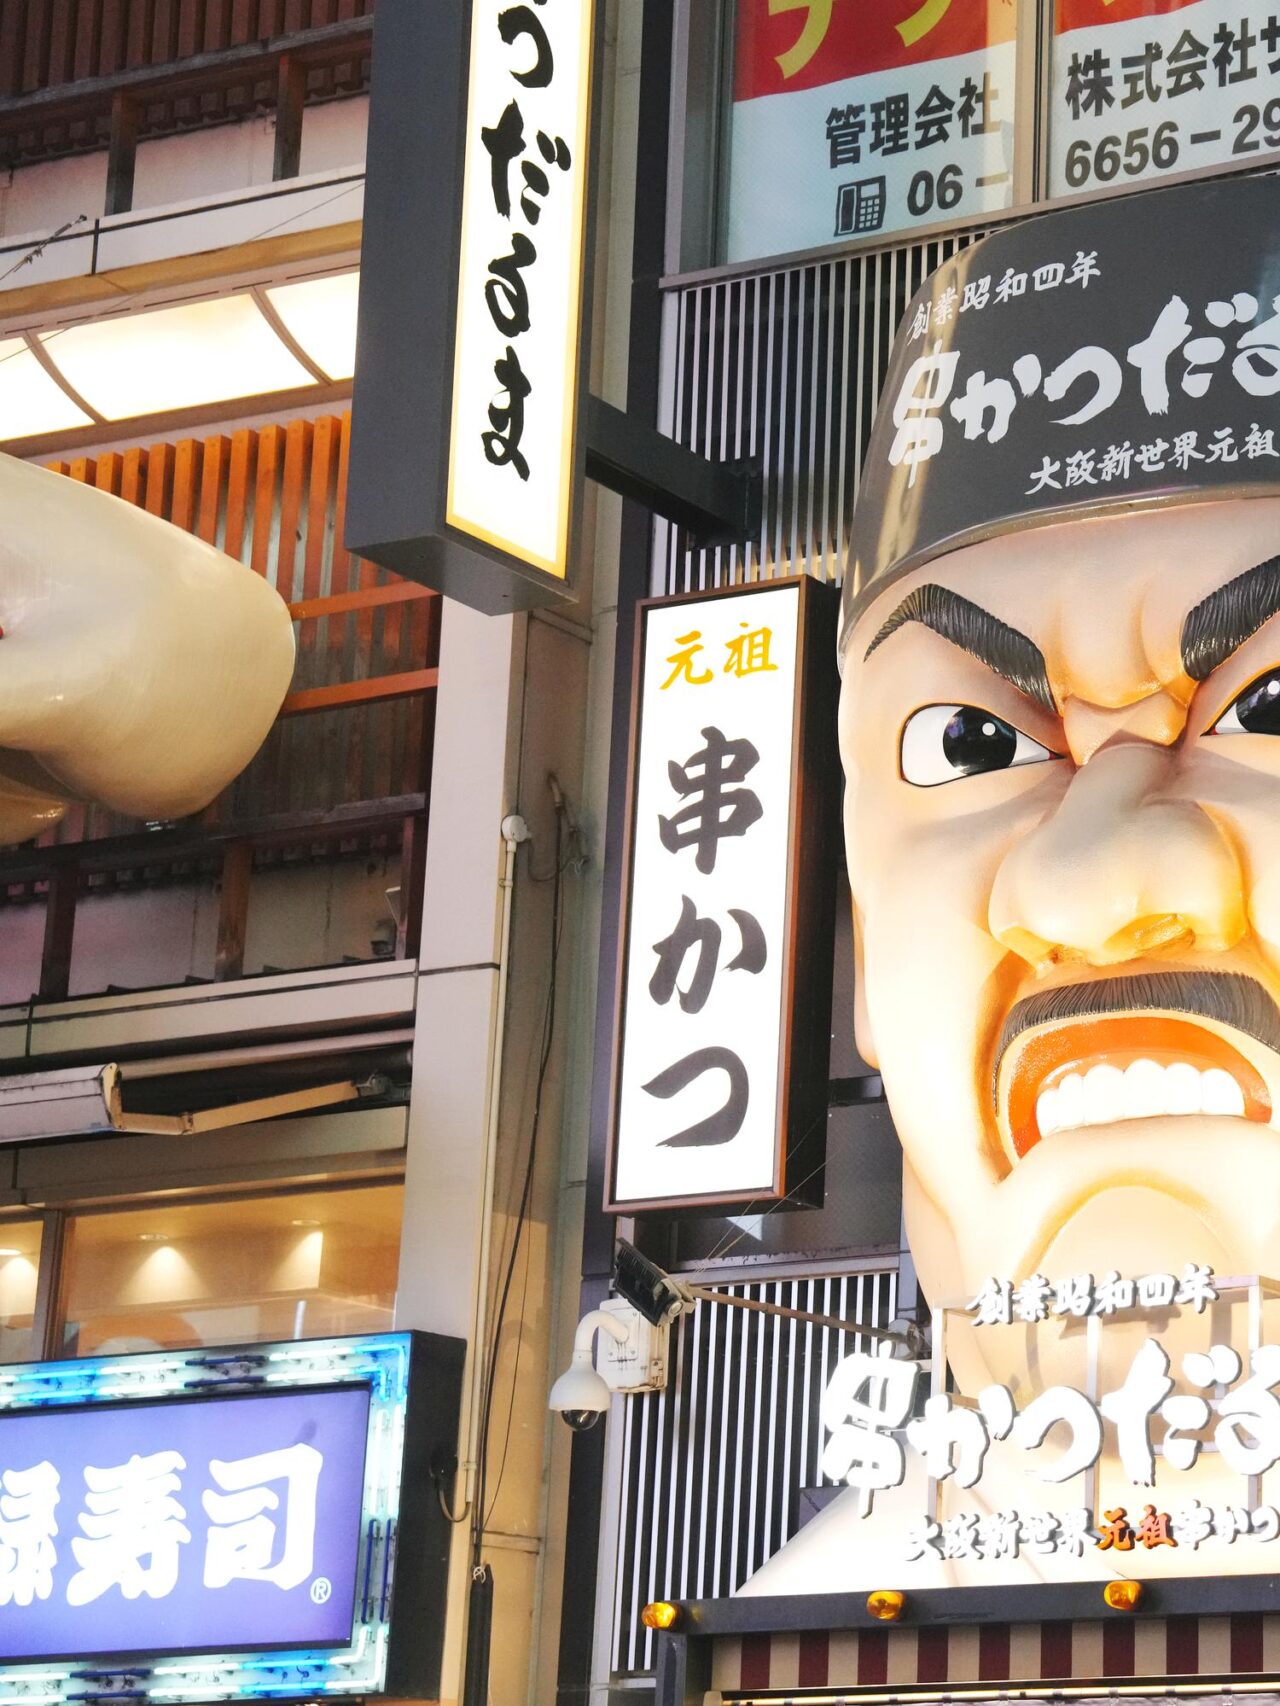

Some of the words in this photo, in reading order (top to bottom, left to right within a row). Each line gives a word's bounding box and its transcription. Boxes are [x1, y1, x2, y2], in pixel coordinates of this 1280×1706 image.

[825, 71, 1001, 169] 管理会社
[480, 0, 572, 482] つだるま
[907, 250, 1102, 346] 創業昭和四年
[658, 621, 779, 690] 元祖
[640, 725, 768, 1148] 串かつ
[965, 1262, 1219, 1327] 創業昭和四年
